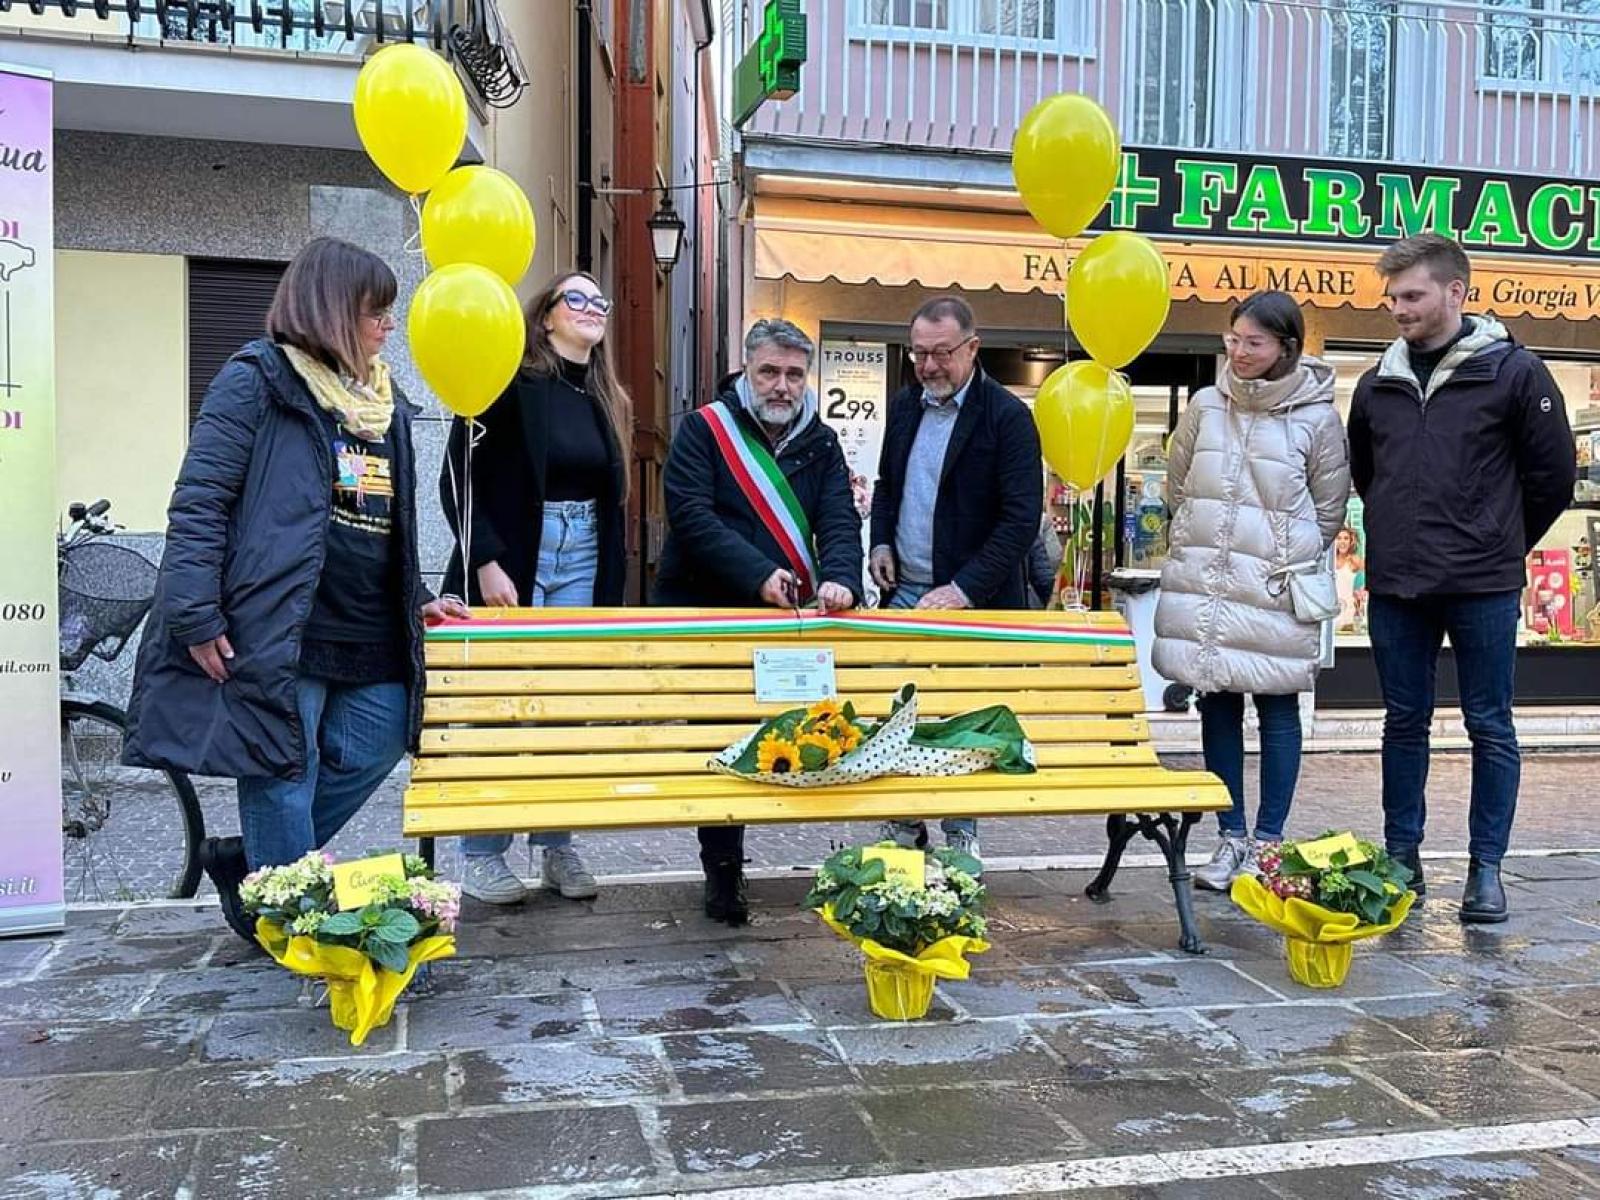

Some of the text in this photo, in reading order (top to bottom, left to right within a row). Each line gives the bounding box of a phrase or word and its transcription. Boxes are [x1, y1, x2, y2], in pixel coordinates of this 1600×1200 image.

[0, 144, 46, 172] ua
[1215, 264, 1257, 290] AL
[1266, 267, 1356, 296] MARE
[1492, 279, 1577, 311] Giorgia
[824, 350, 884, 364] TROUSS
[2, 603, 45, 621] 080
